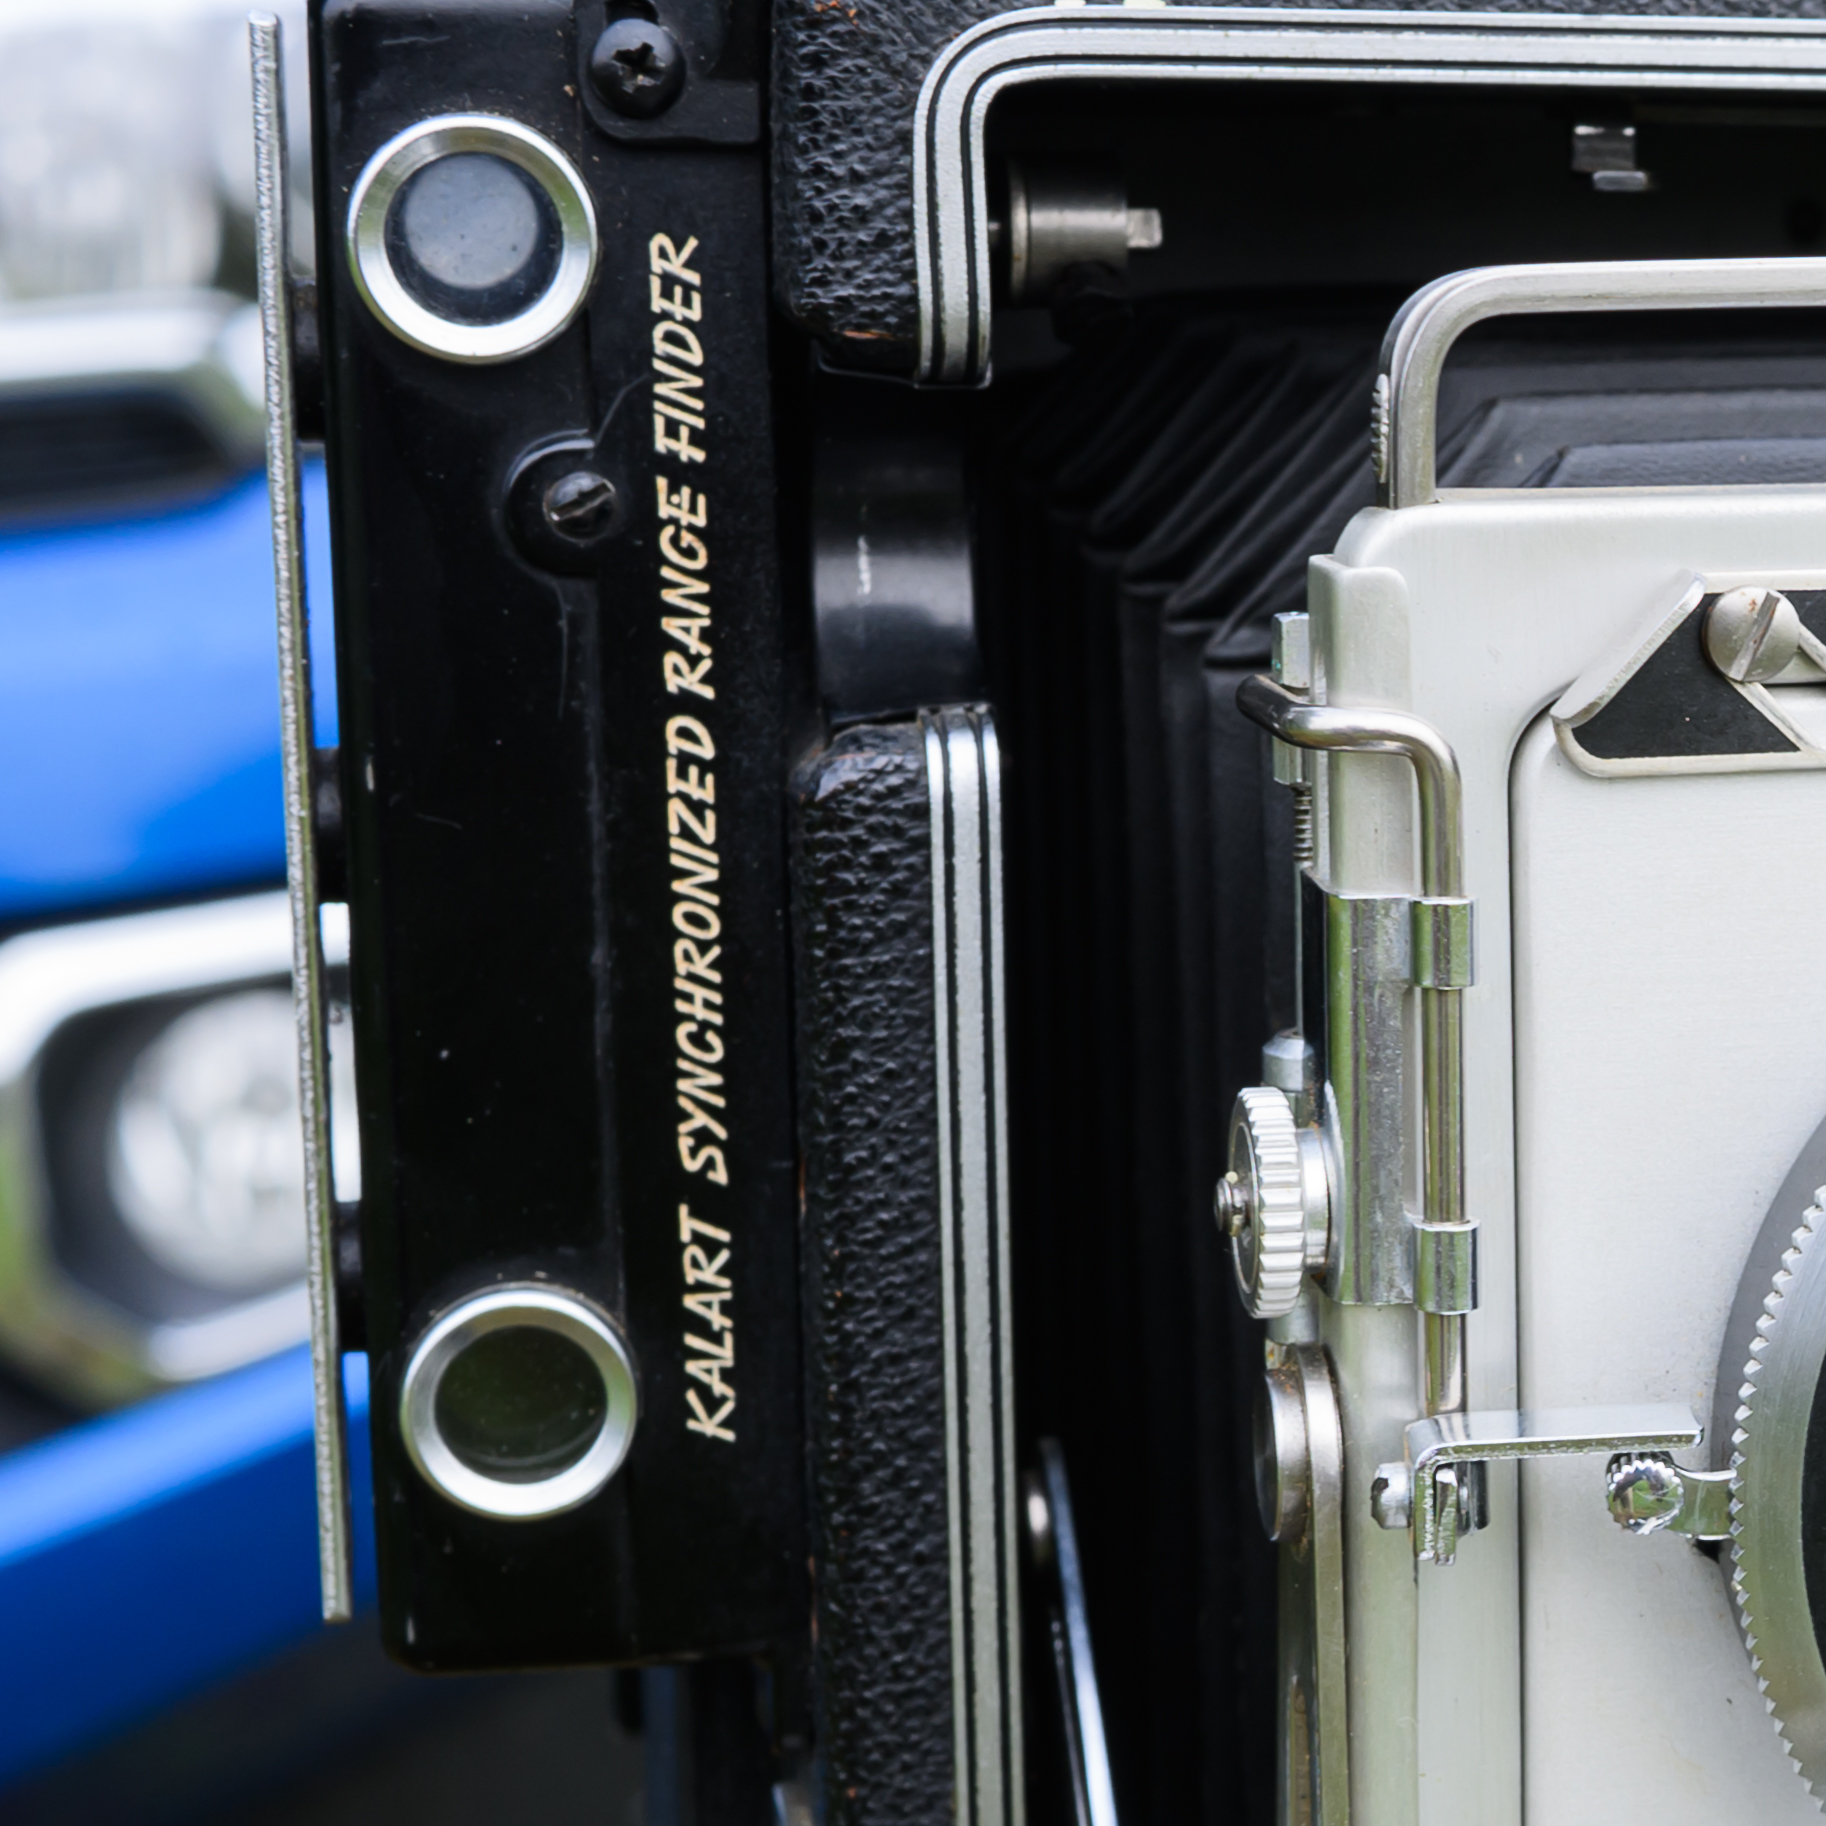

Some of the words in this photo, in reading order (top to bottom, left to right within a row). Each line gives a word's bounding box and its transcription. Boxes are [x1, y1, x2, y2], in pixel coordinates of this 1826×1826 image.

[649, 232, 706, 463] FINDER
[656, 475, 715, 700] RANGE
[665, 715, 729, 1186] SYNCHRONIZED
[679, 1204, 737, 1442] KALART
